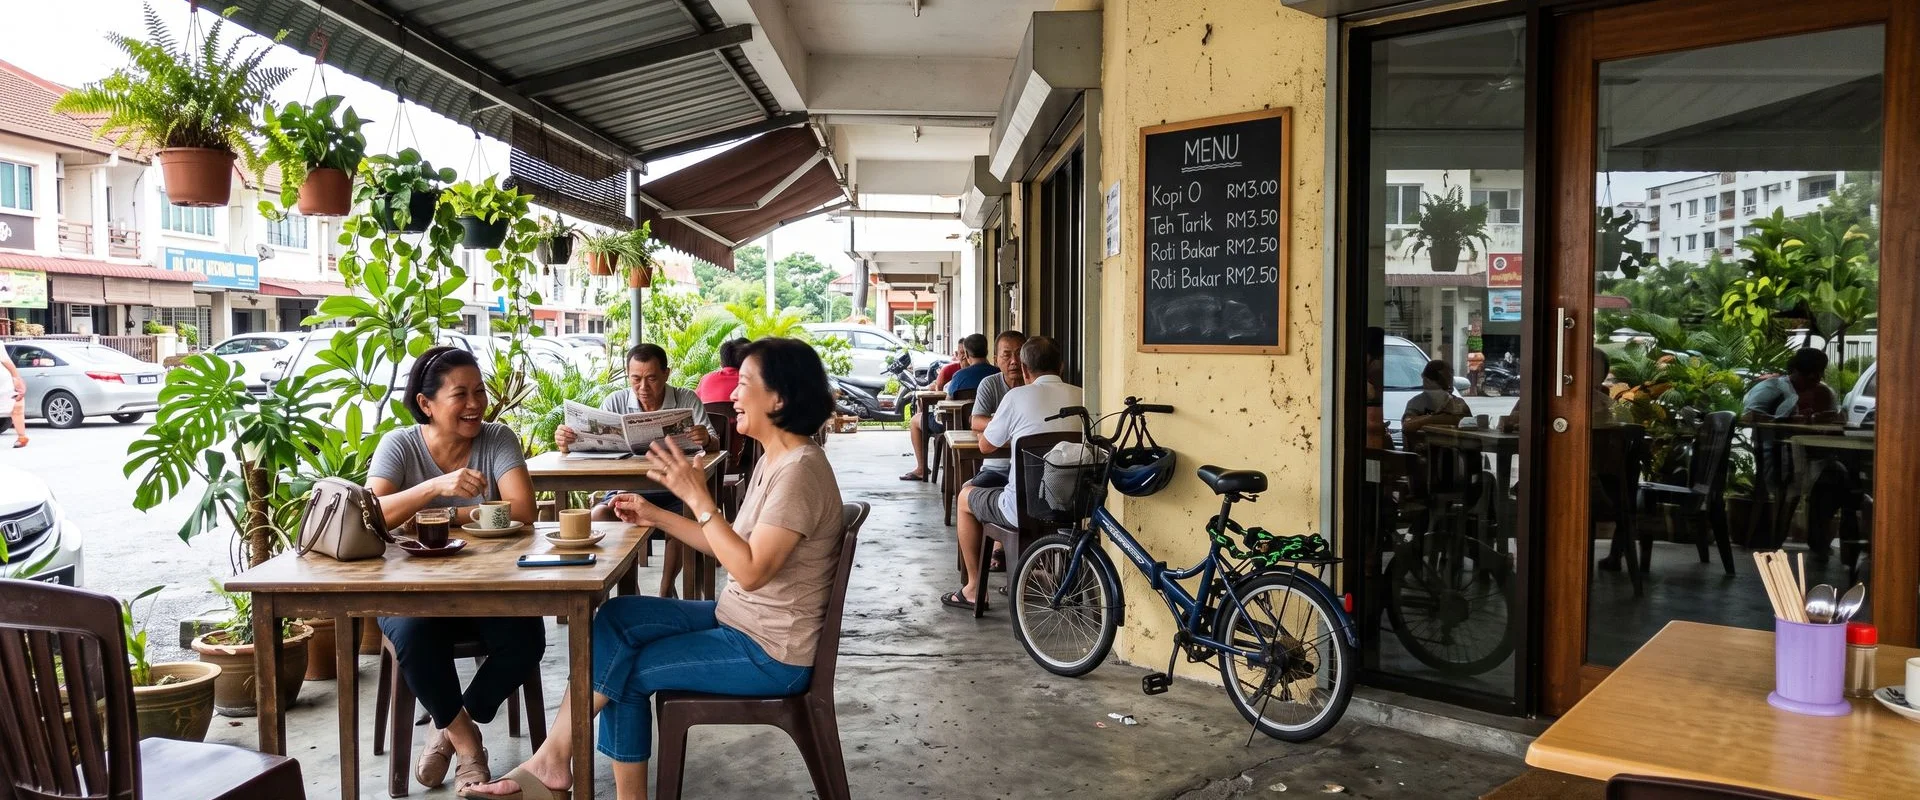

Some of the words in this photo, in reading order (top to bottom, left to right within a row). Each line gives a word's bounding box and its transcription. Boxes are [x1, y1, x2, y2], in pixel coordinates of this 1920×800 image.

[1185, 134, 1239, 164] MENU
[1153, 185, 1182, 211] Kopi
[1188, 181, 1201, 202] O
[1227, 180, 1277, 198] RM3.00
[1150, 216, 1174, 235] Teh
[1178, 211, 1213, 233] Tarik
[1227, 209, 1277, 228] RM3.50
[1151, 242, 1175, 261] Roti
[1181, 240, 1220, 260] Bakar
[1226, 237, 1277, 255] RM2.50
[1151, 268, 1176, 289] Roti
[1182, 267, 1221, 288] Bakar
[1226, 266, 1277, 285] RM2.50
